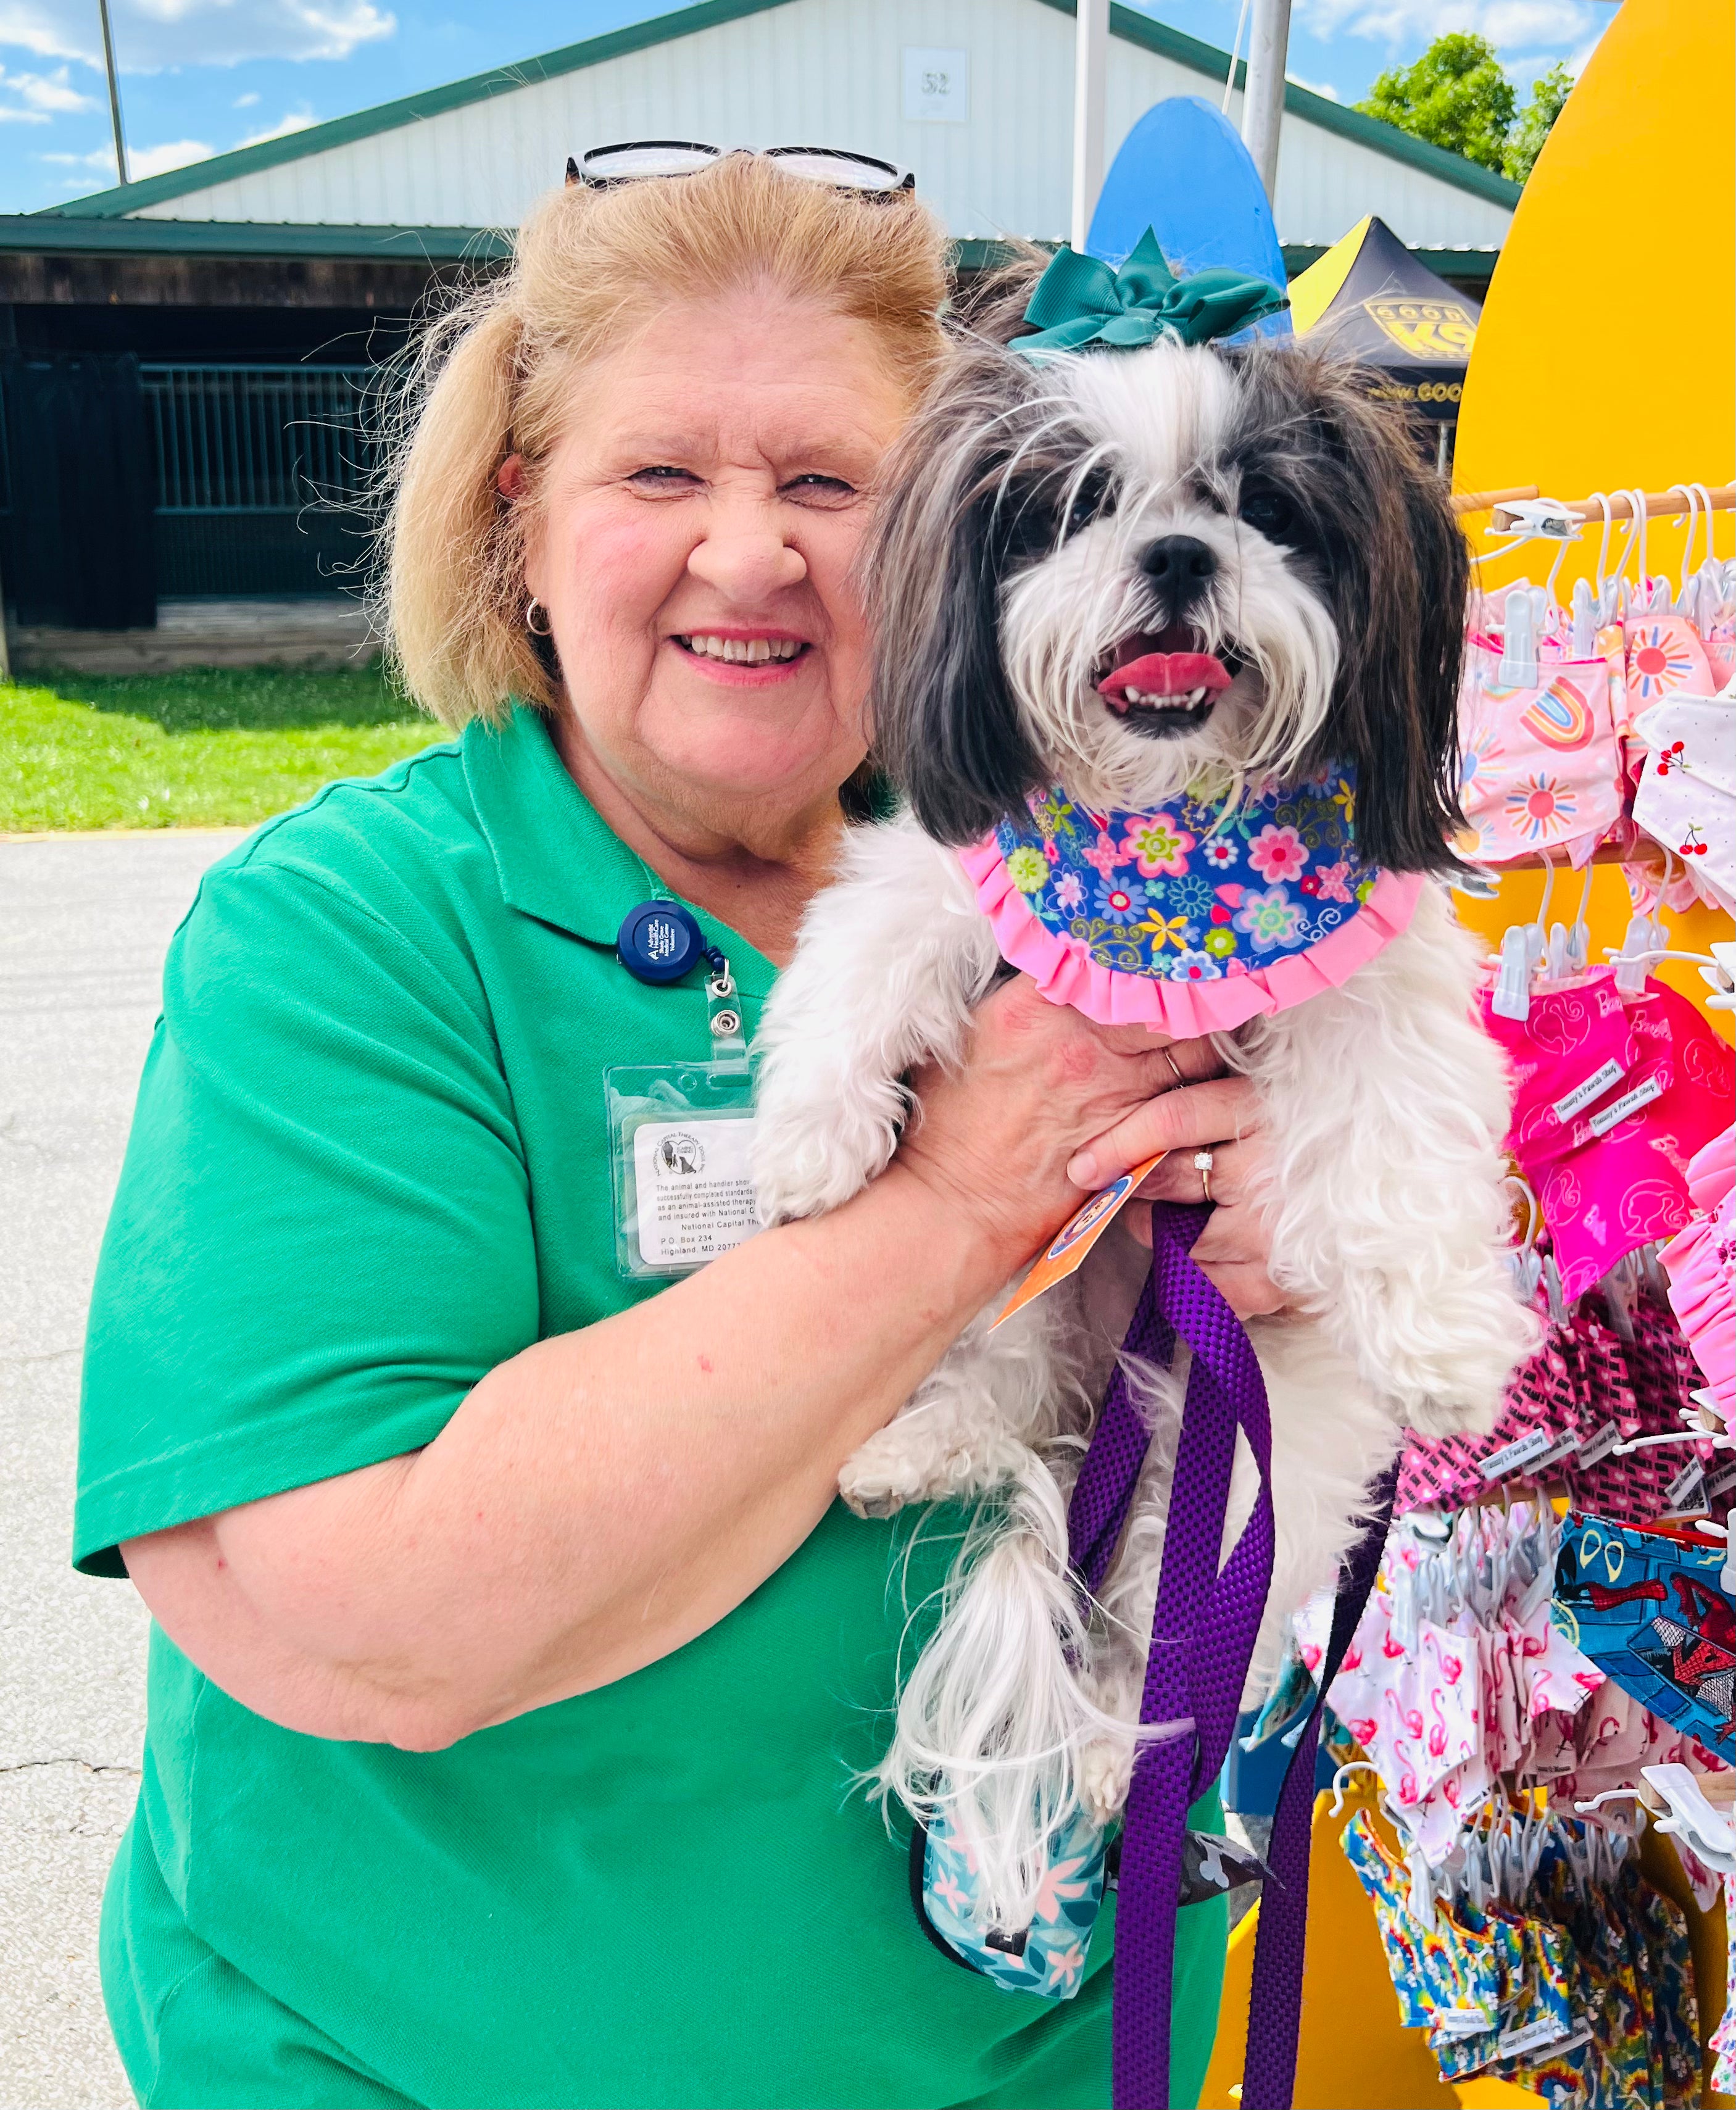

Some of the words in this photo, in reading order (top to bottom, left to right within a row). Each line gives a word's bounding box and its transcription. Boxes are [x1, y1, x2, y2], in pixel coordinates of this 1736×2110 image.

[921, 72, 950, 95] 52
[1377, 304, 1463, 322] GOOD
[1386, 322, 1477, 352] K9
[657, 1132, 678, 1147] CAPITAL
[678, 1131, 700, 1145] THERAPY
[671, 1182, 692, 1190] animal
[708, 1179, 733, 1187] handler
[657, 1193, 692, 1202] successfully
[694, 1190, 723, 1200] completed
[725, 1189, 753, 1197] standards
[678, 1200, 730, 1210] animal-assisted
[674, 1211, 699, 1220] insured
[702, 1210, 716, 1218] with
[718, 1208, 747, 1216] National
[681, 1222, 714, 1231] National
[716, 1219, 744, 1228] Capital
